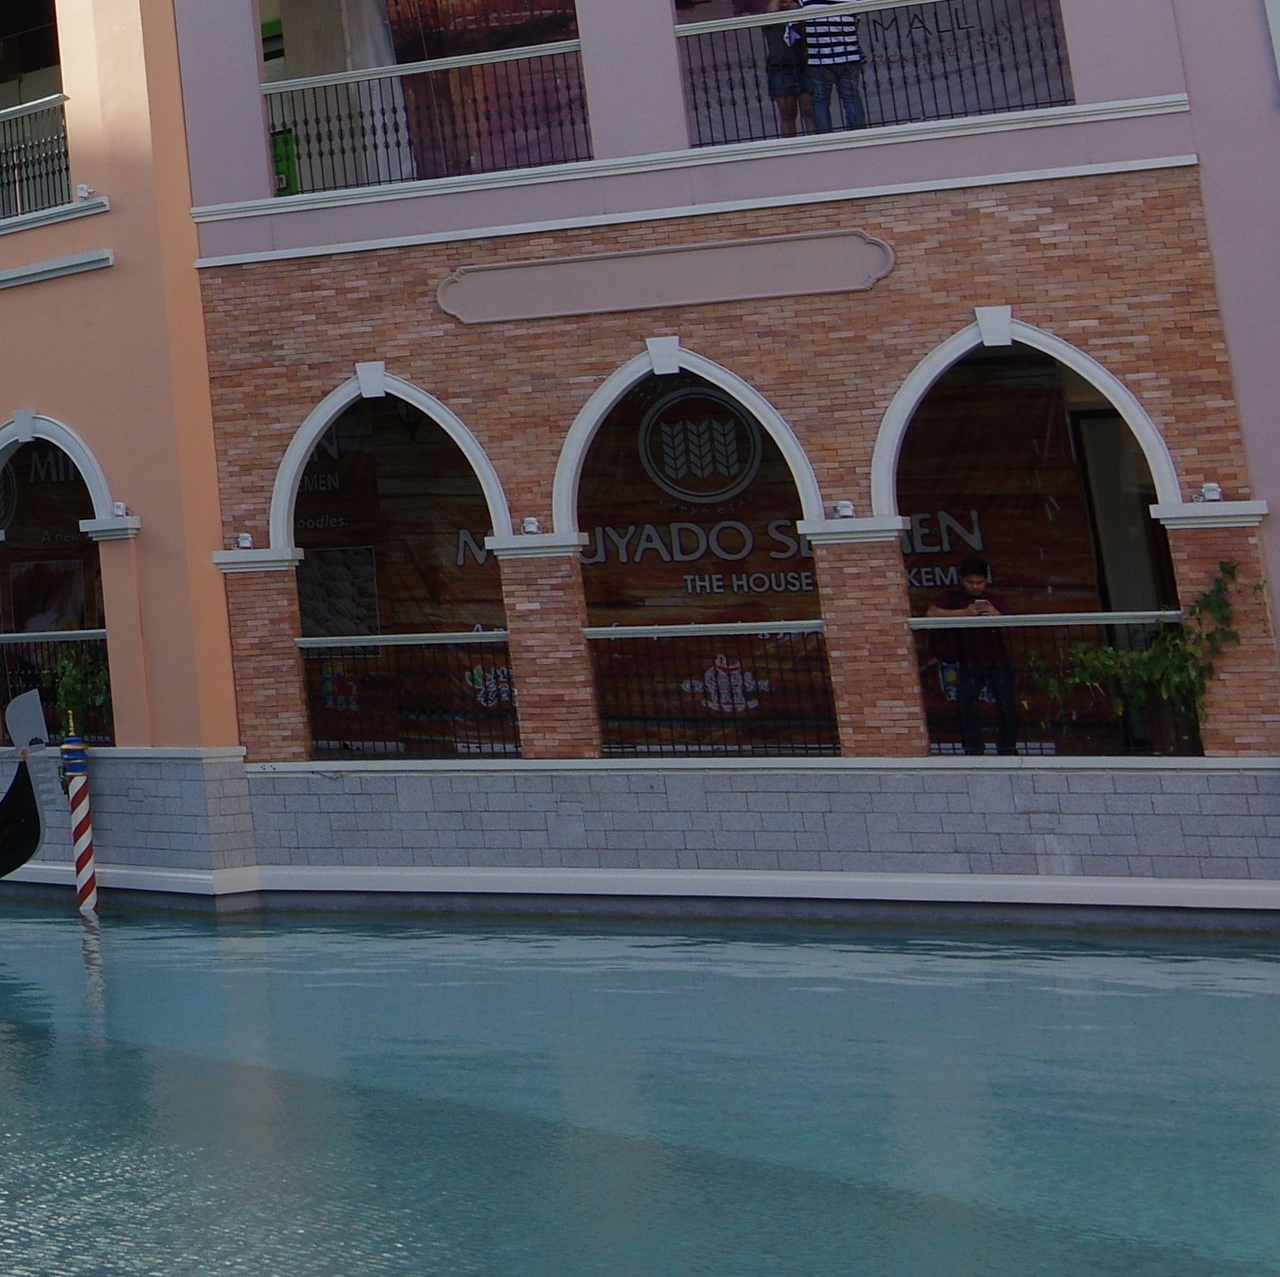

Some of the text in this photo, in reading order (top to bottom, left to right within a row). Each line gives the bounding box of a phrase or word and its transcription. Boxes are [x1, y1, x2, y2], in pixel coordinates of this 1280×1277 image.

[872, 7, 975, 43] MALL
[683, 573, 725, 594] THE
[732, 571, 814, 593] HOUSE
